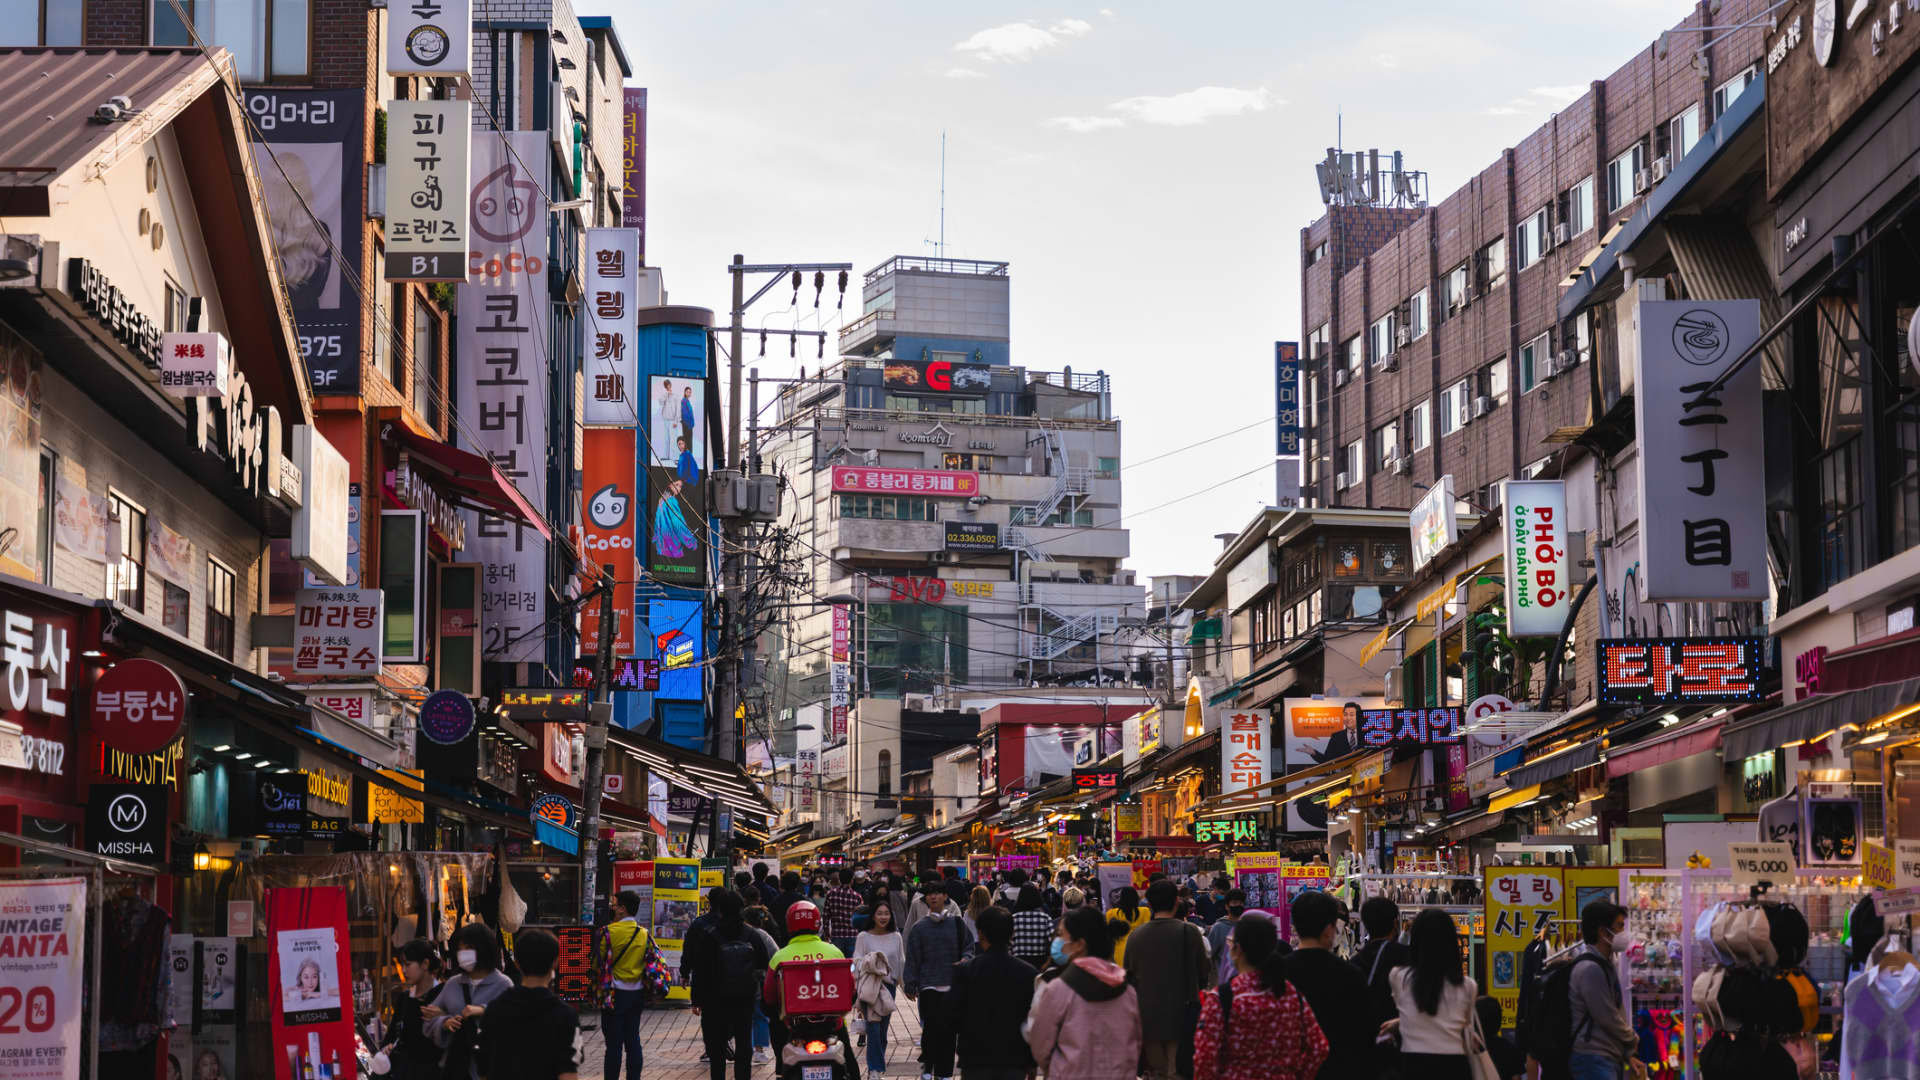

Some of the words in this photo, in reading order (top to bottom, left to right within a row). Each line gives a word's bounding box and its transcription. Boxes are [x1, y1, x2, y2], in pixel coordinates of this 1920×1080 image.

[241, 91, 334, 130] 임머리
[391, 218, 460, 243] 프렌즈
[411, 255, 439, 275] B1
[595, 249, 625, 403] 힐링카페
[174, 343, 206, 360] 米线
[162, 370, 216, 387] 원남쌀국수
[314, 369, 338, 386] 3F
[1279, 366, 1299, 452] 호미화방
[1678, 381, 1733, 567] 三丁目
[584, 534, 633, 550] CoCo
[1533, 506, 1564, 563] PHỞ
[486, 563, 516, 583] 홍대
[1516, 547, 1528, 575] BÁN
[890, 576, 946, 603] DVD
[1517, 577, 1531, 608] PHỞ
[1536, 569, 1566, 608] BÒ
[299, 605, 378, 630] 마라탕
[484, 626, 521, 656] 2F
[296, 646, 377, 670] 쌀국수
[1606, 643, 1755, 698] 타로
[95, 691, 178, 723] 부동산
[375, 798, 392, 808] for
[375, 807, 417, 818] school
[310, 819, 340, 831] BAG
[98, 841, 154, 855] MISSHA
[1736, 860, 1788, 874] ₩5,000
[1500, 877, 1555, 904] 힐링
[797, 983, 839, 999] 요기요
